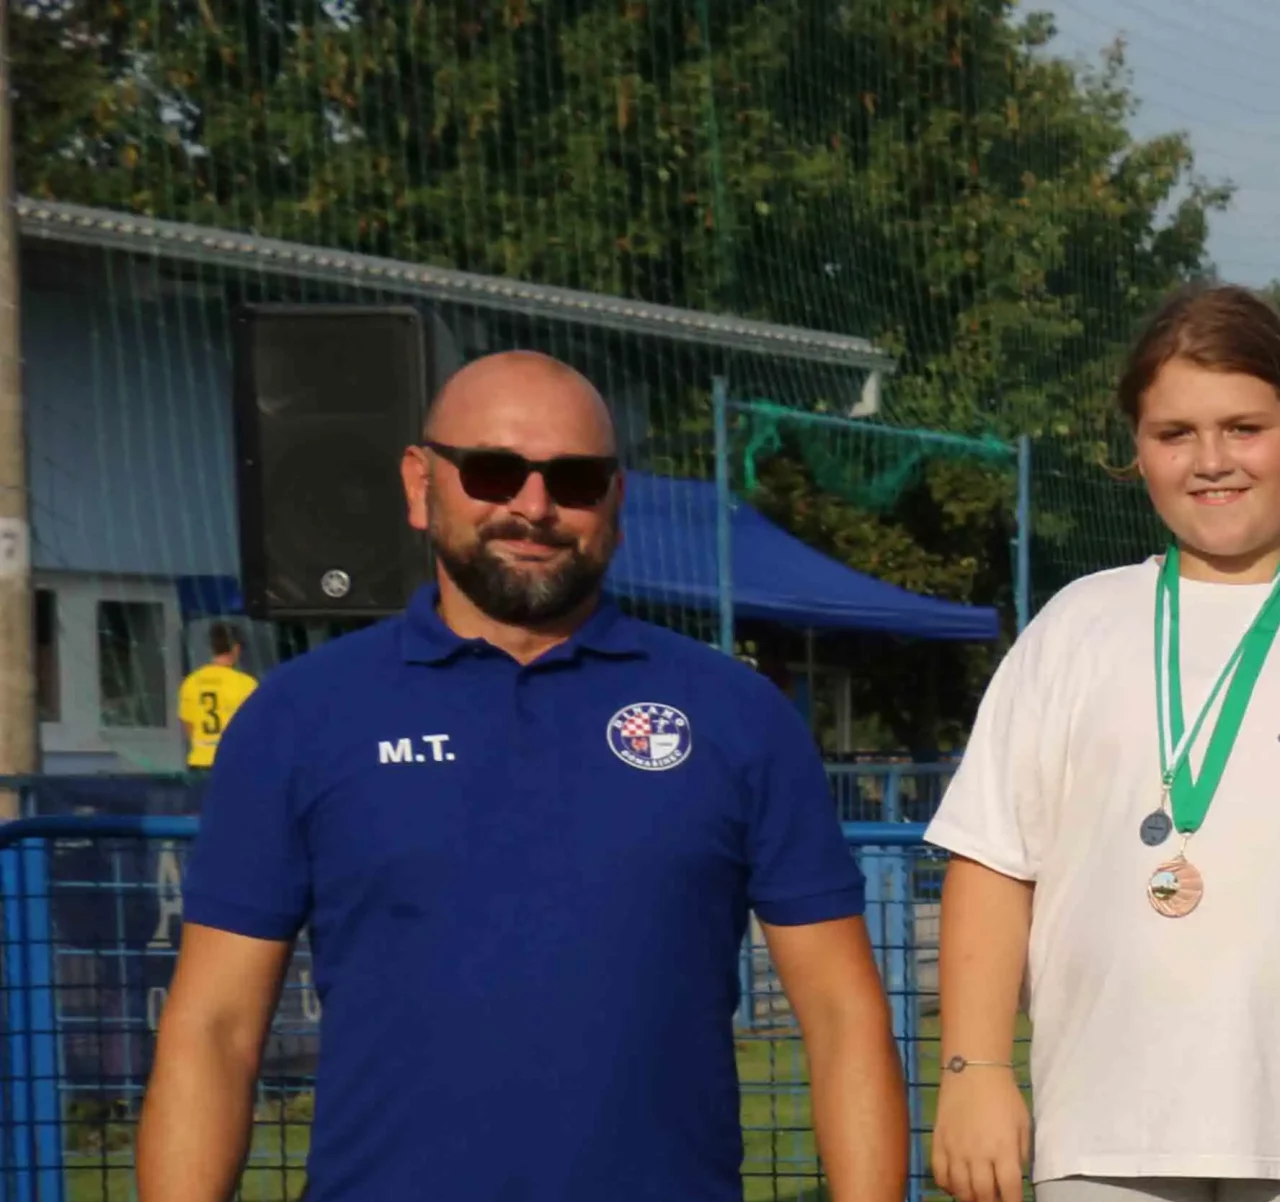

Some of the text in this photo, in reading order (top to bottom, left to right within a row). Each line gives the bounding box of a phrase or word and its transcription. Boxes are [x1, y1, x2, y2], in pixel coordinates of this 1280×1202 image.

[200, 691, 221, 735] 3
[613, 705, 685, 729] DINAMO
[378, 734, 456, 763] M.T.
